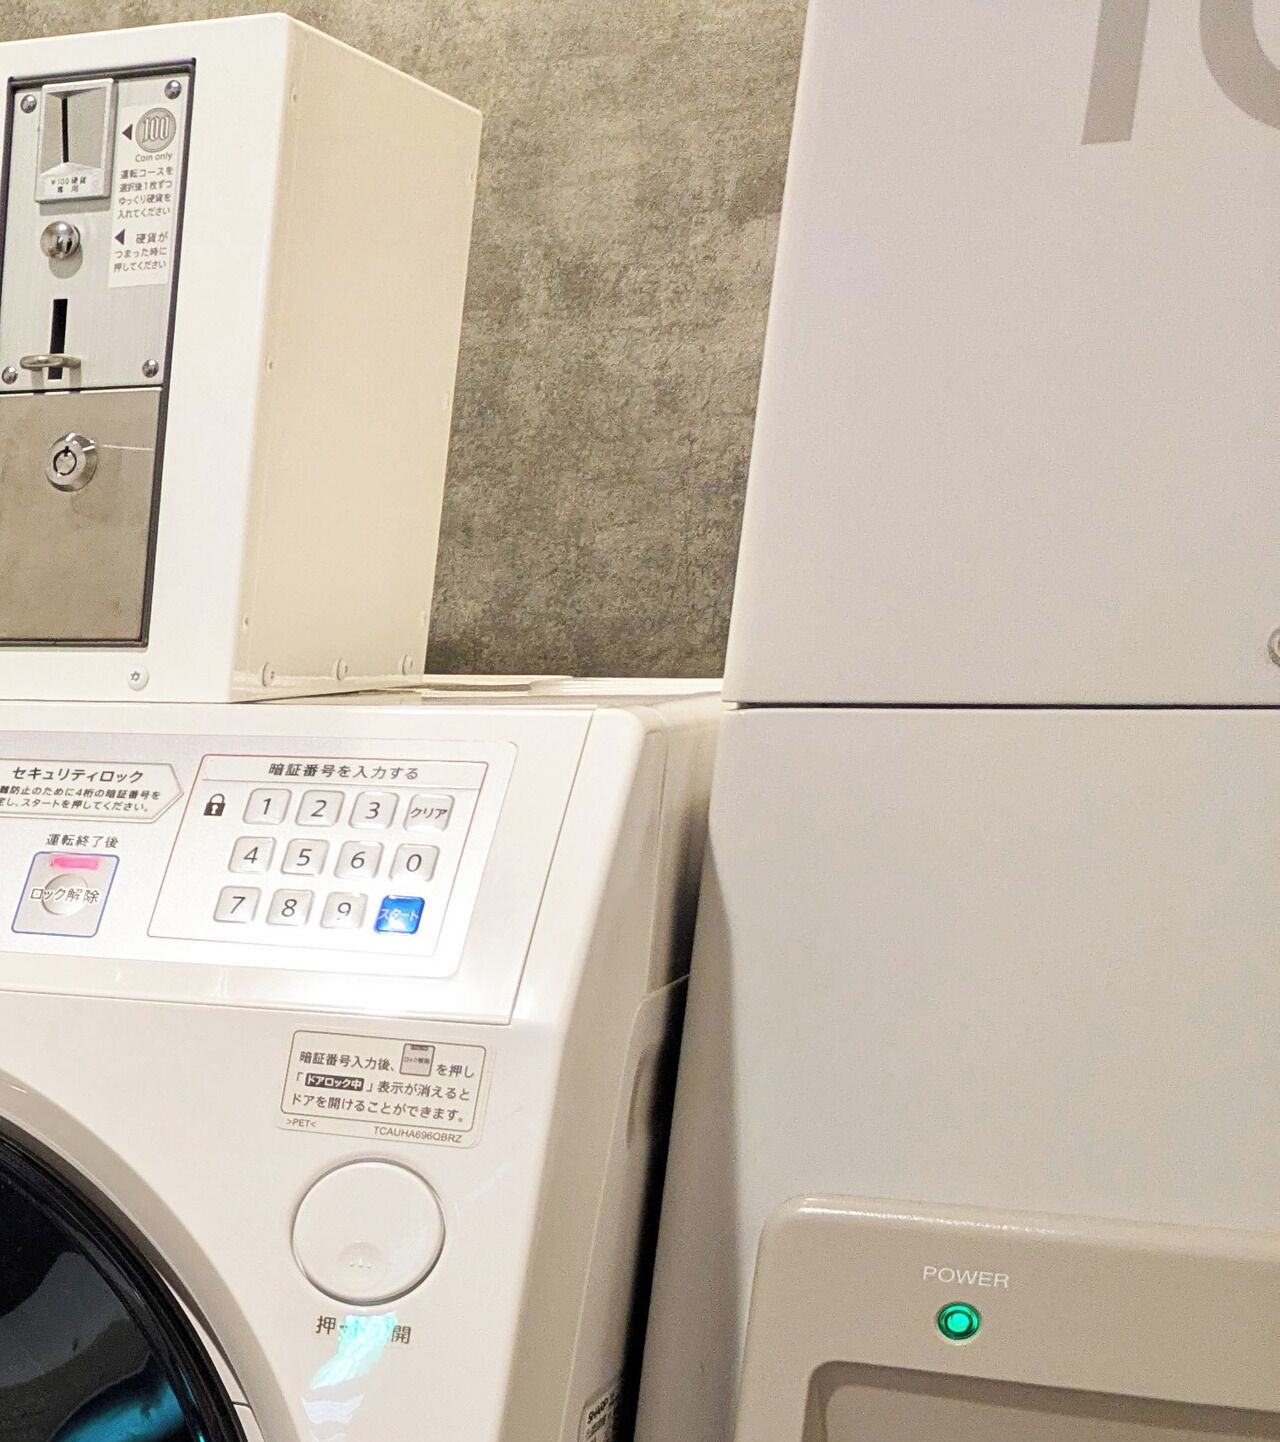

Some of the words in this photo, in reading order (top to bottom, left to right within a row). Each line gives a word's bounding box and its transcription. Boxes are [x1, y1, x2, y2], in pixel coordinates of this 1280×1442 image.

[135, 154, 153, 162] Coin
[155, 153, 173, 163] only
[120, 167, 174, 180] 運転コースを
[118, 193, 172, 206] ゆっくり硬貨を
[117, 207, 170, 220] 入れてください
[136, 232, 168, 244] 硬貨が
[114, 246, 168, 258] つまった時に
[114, 260, 166, 272] 押してください
[12, 766, 144, 784] セキュリティロック
[268, 763, 419, 780] 暗証番号を入力する
[263, 798, 271, 815] 1
[311, 800, 326, 817] 2
[366, 802, 380, 818] 3
[410, 806, 448, 819] クリア
[46, 834, 118, 848] 運転終了後
[244, 846, 258, 864] 4
[297, 849, 312, 866] 5
[350, 851, 364, 868] 6
[406, 854, 422, 872] 0
[30, 887, 99, 904] ロック解除
[230, 896, 245, 914] 7
[281, 899, 297, 916] 8
[337, 902, 351, 920] 9
[378, 908, 419, 922] スタート
[300, 1051, 395, 1072] 暗証番号入力後、
[436, 1064, 474, 1078] を押し
[292, 1093, 464, 1123] ドアを開けることができます。
[922, 1265, 1010, 1290] POWER
